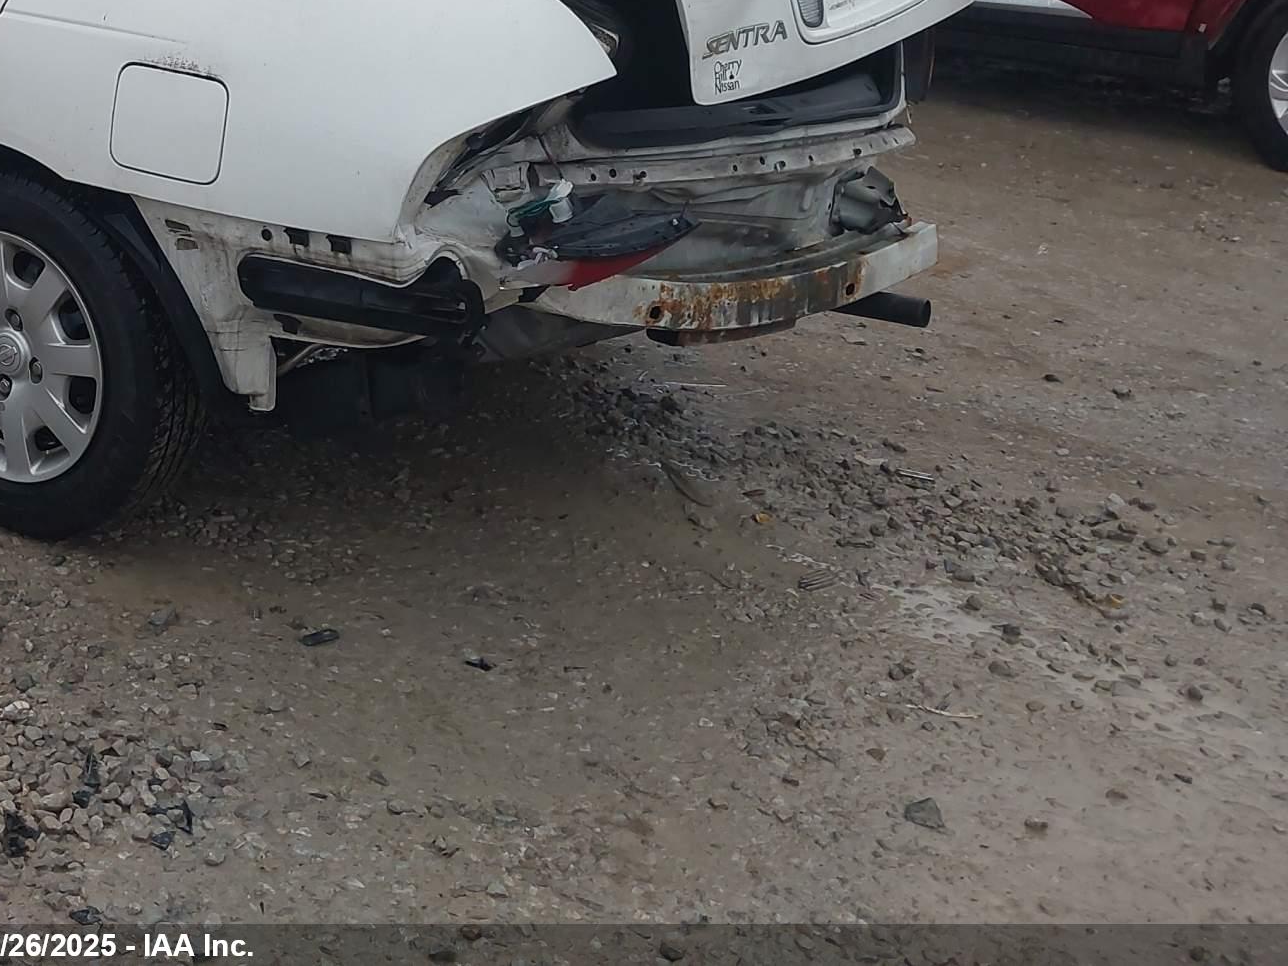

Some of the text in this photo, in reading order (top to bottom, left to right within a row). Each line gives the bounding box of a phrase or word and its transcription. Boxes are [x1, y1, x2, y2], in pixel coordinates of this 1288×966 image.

[702, 20, 788, 60] SENTRA
[714, 59, 742, 76] Cherry
[715, 80, 740, 95] Nissan
